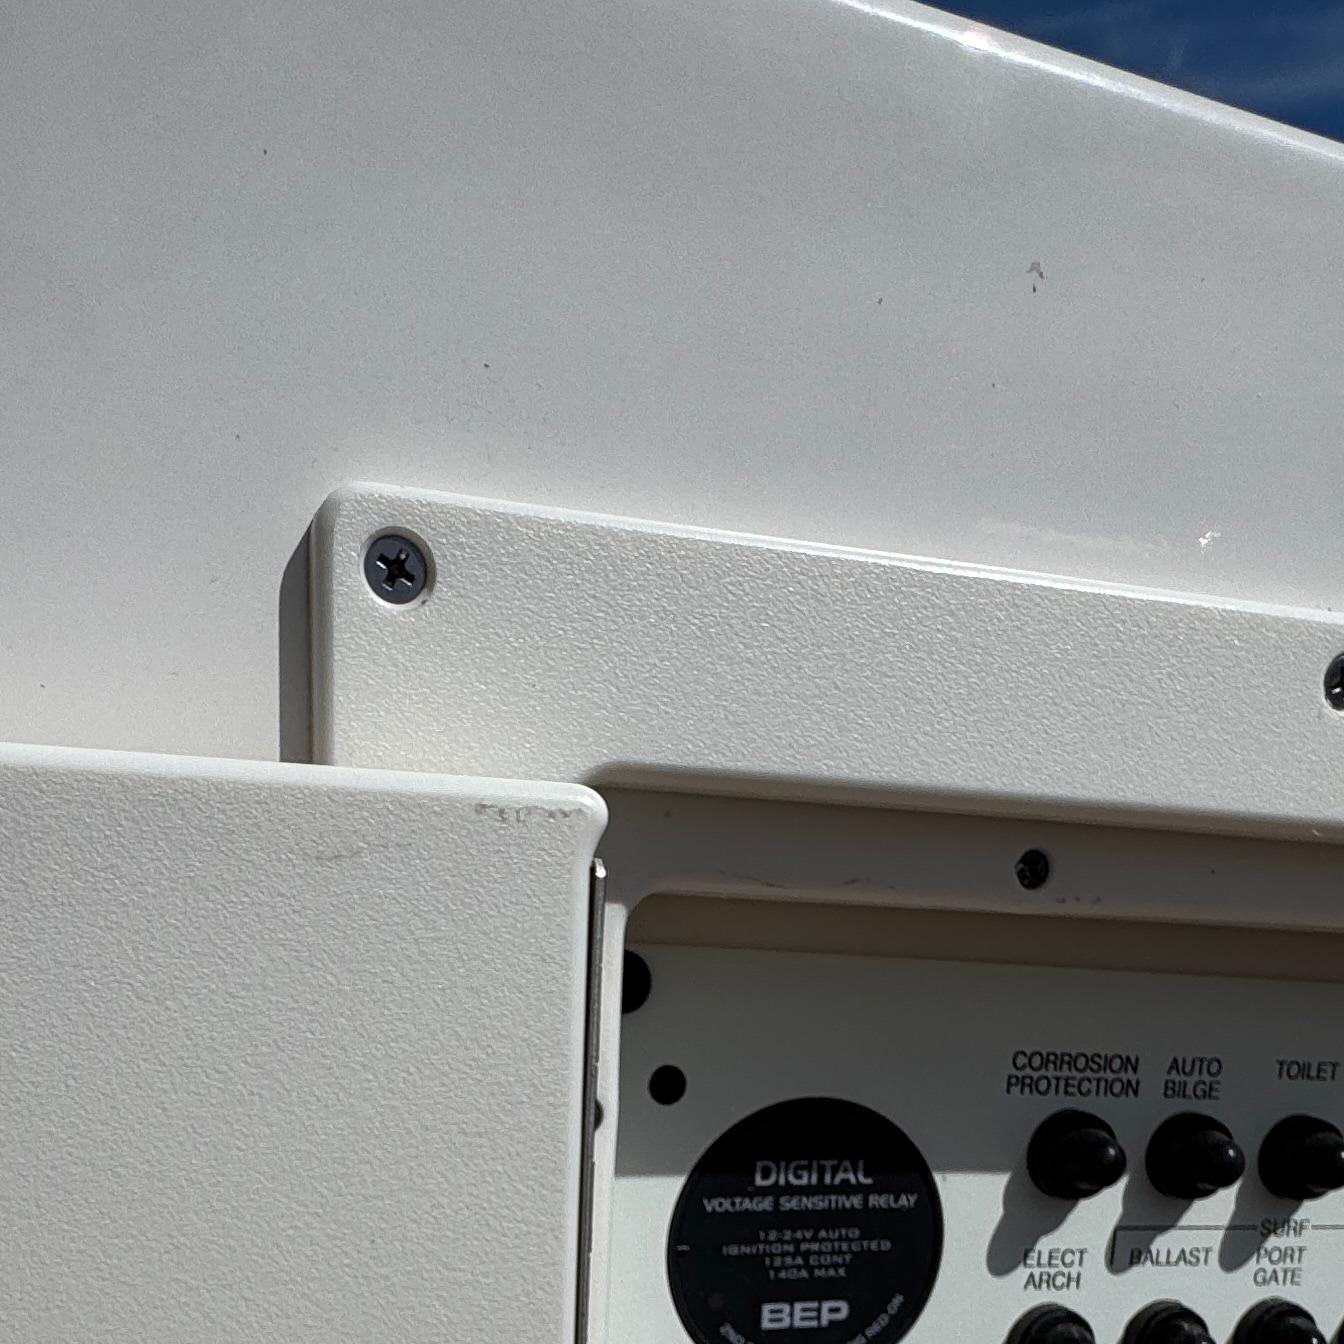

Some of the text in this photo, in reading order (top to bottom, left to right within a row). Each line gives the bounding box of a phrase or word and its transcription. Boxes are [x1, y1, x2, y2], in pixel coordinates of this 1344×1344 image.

[1011, 1050, 1140, 1075] CORROSION
[1167, 1056, 1223, 1079] AUTO
[1276, 1060, 1340, 1082] TOILET
[1006, 1075, 1140, 1099] PROTECTION
[1163, 1078, 1221, 1100] BILGE
[754, 1159, 874, 1187] DIGITAL
[702, 1192, 918, 1213] VOLTAGE SENSITIVE RELAY
[817, 1227, 861, 1240] AUTO
[1259, 1218, 1310, 1239] SURF
[722, 1239, 892, 1256] IGNITION PROTECTED
[1128, 1246, 1213, 1267] BALLAST
[1257, 1245, 1306, 1265] PORT
[809, 1253, 852, 1266] CONT
[1022, 1248, 1087, 1269] ELECT
[813, 1265, 848, 1279] MAX
[1023, 1270, 1081, 1292] ARCH
[1253, 1266, 1302, 1287] GATE
[760, 1300, 850, 1330] BEP
